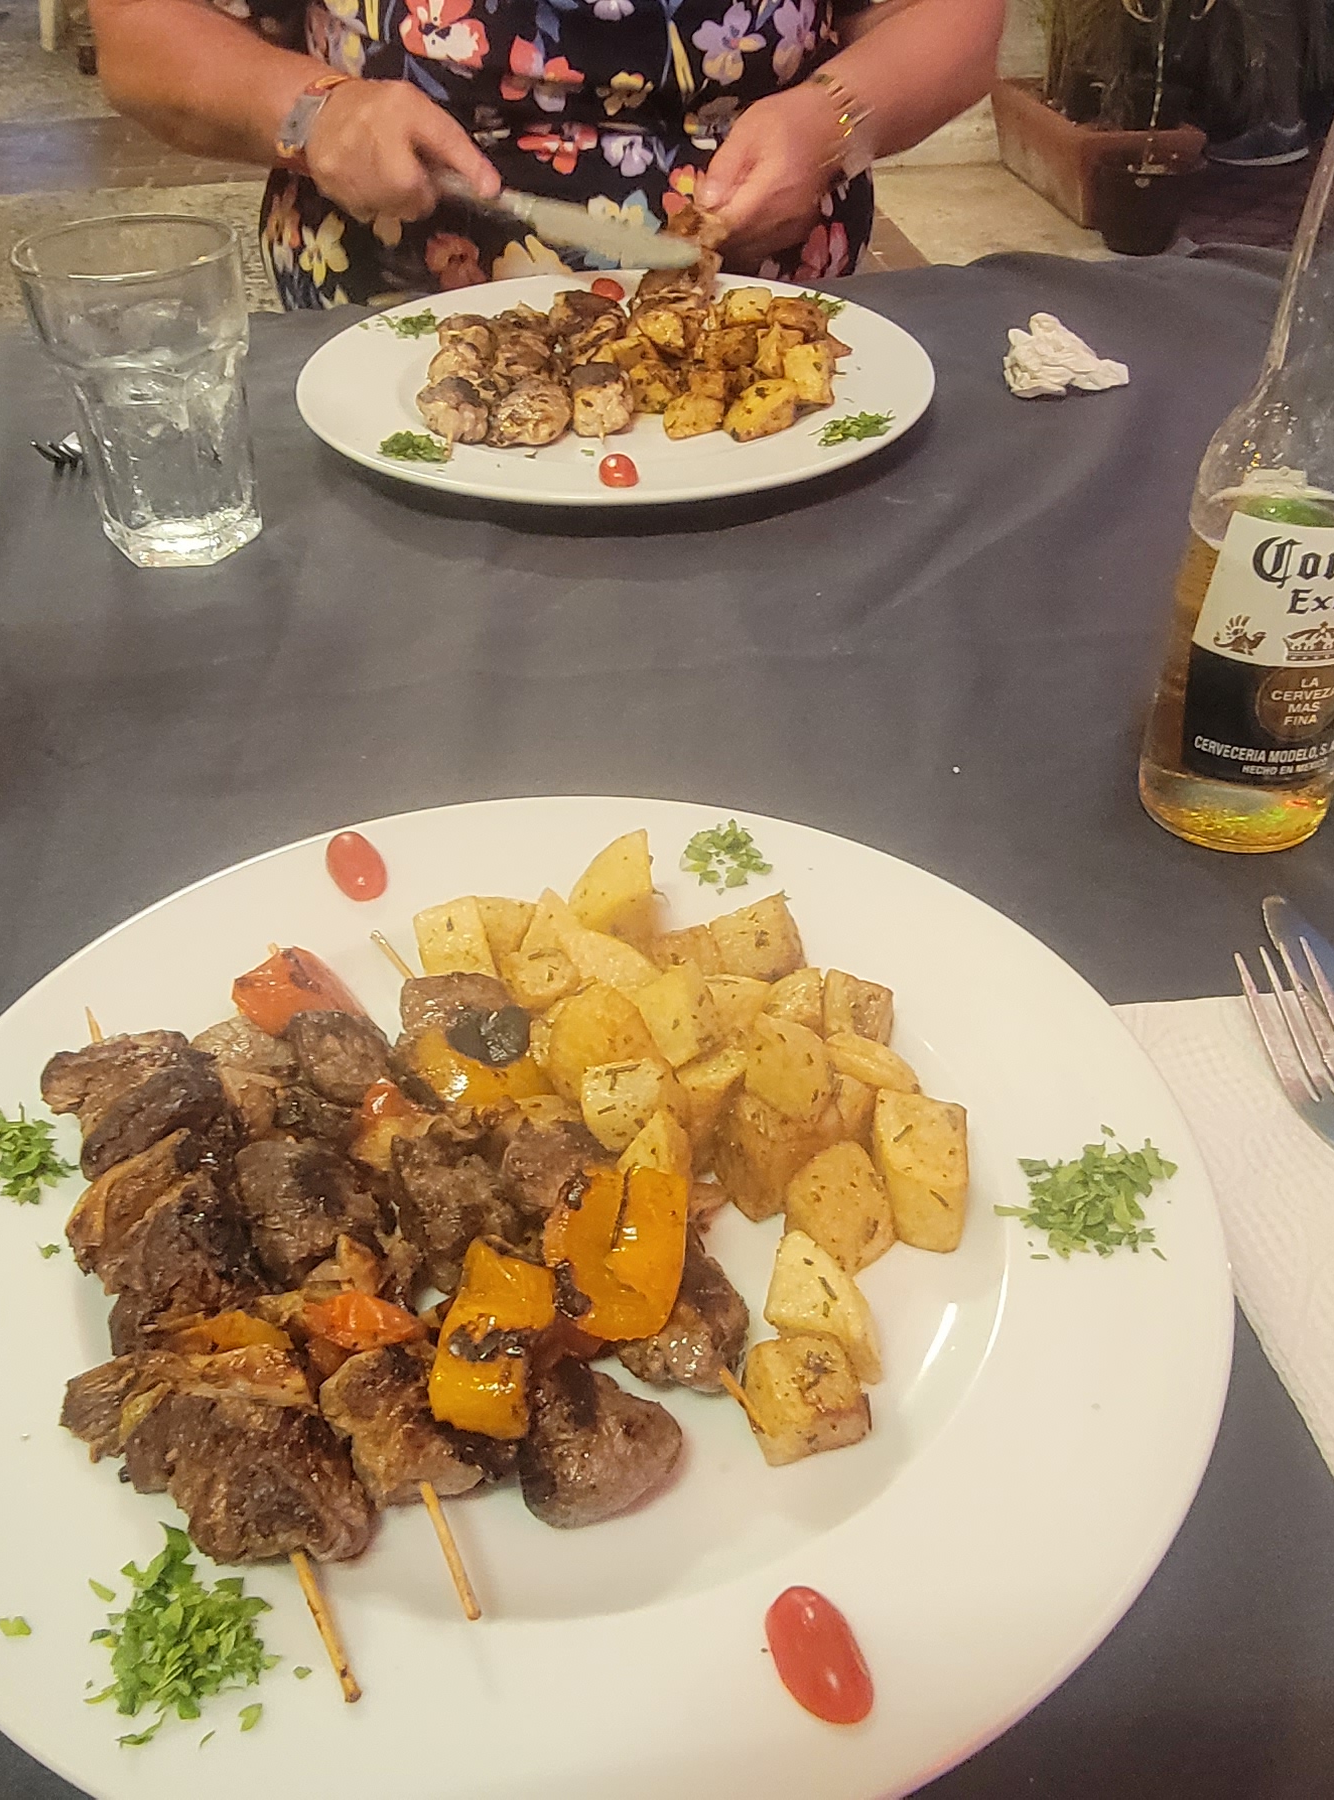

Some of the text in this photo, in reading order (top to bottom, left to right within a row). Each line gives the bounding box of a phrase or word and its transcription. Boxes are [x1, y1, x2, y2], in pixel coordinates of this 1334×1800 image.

[1301, 677, 1320, 689] LA
[1287, 701, 1321, 714] MAS
[1283, 714, 1318, 726] FINA
[1193, 734, 1267, 763] CERVECERIA
[1241, 764, 1279, 776] HECHO
[1279, 765, 1295, 776] EN
